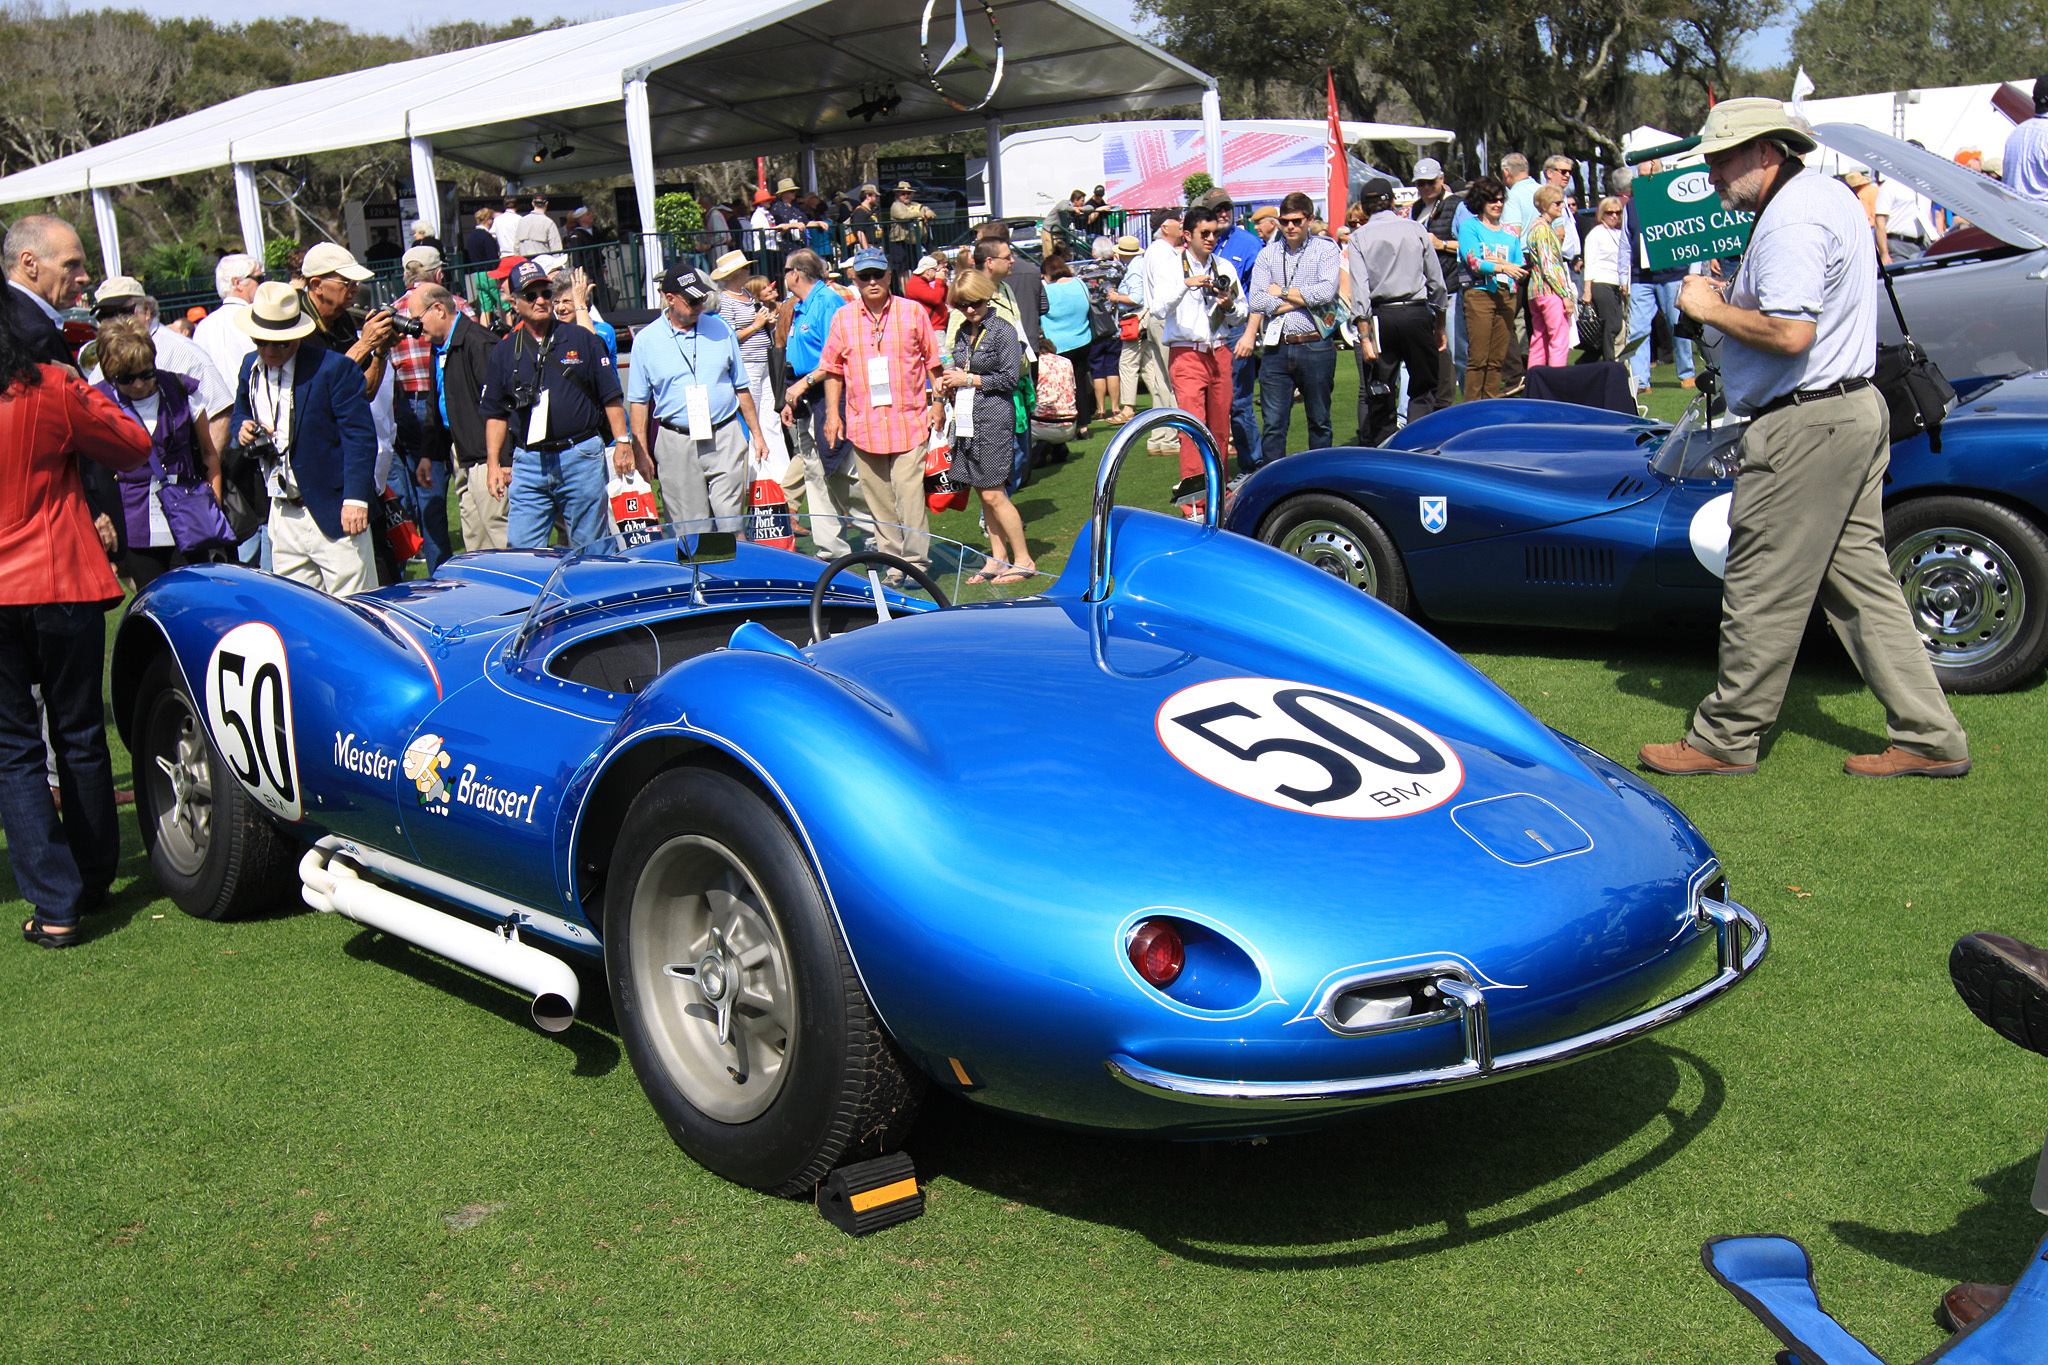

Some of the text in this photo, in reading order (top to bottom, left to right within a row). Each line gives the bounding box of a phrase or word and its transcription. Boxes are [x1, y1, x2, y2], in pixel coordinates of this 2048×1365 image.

[1645, 215, 1706, 242] SPORTS
[1671, 243, 1700, 262] 1950
[1711, 235, 1742, 253] 1954
[218, 650, 296, 803] 50
[333, 730, 397, 781] Meister
[1170, 688, 1446, 808] 50
[262, 792, 288, 814] BM
[1369, 781, 1432, 807] BM
